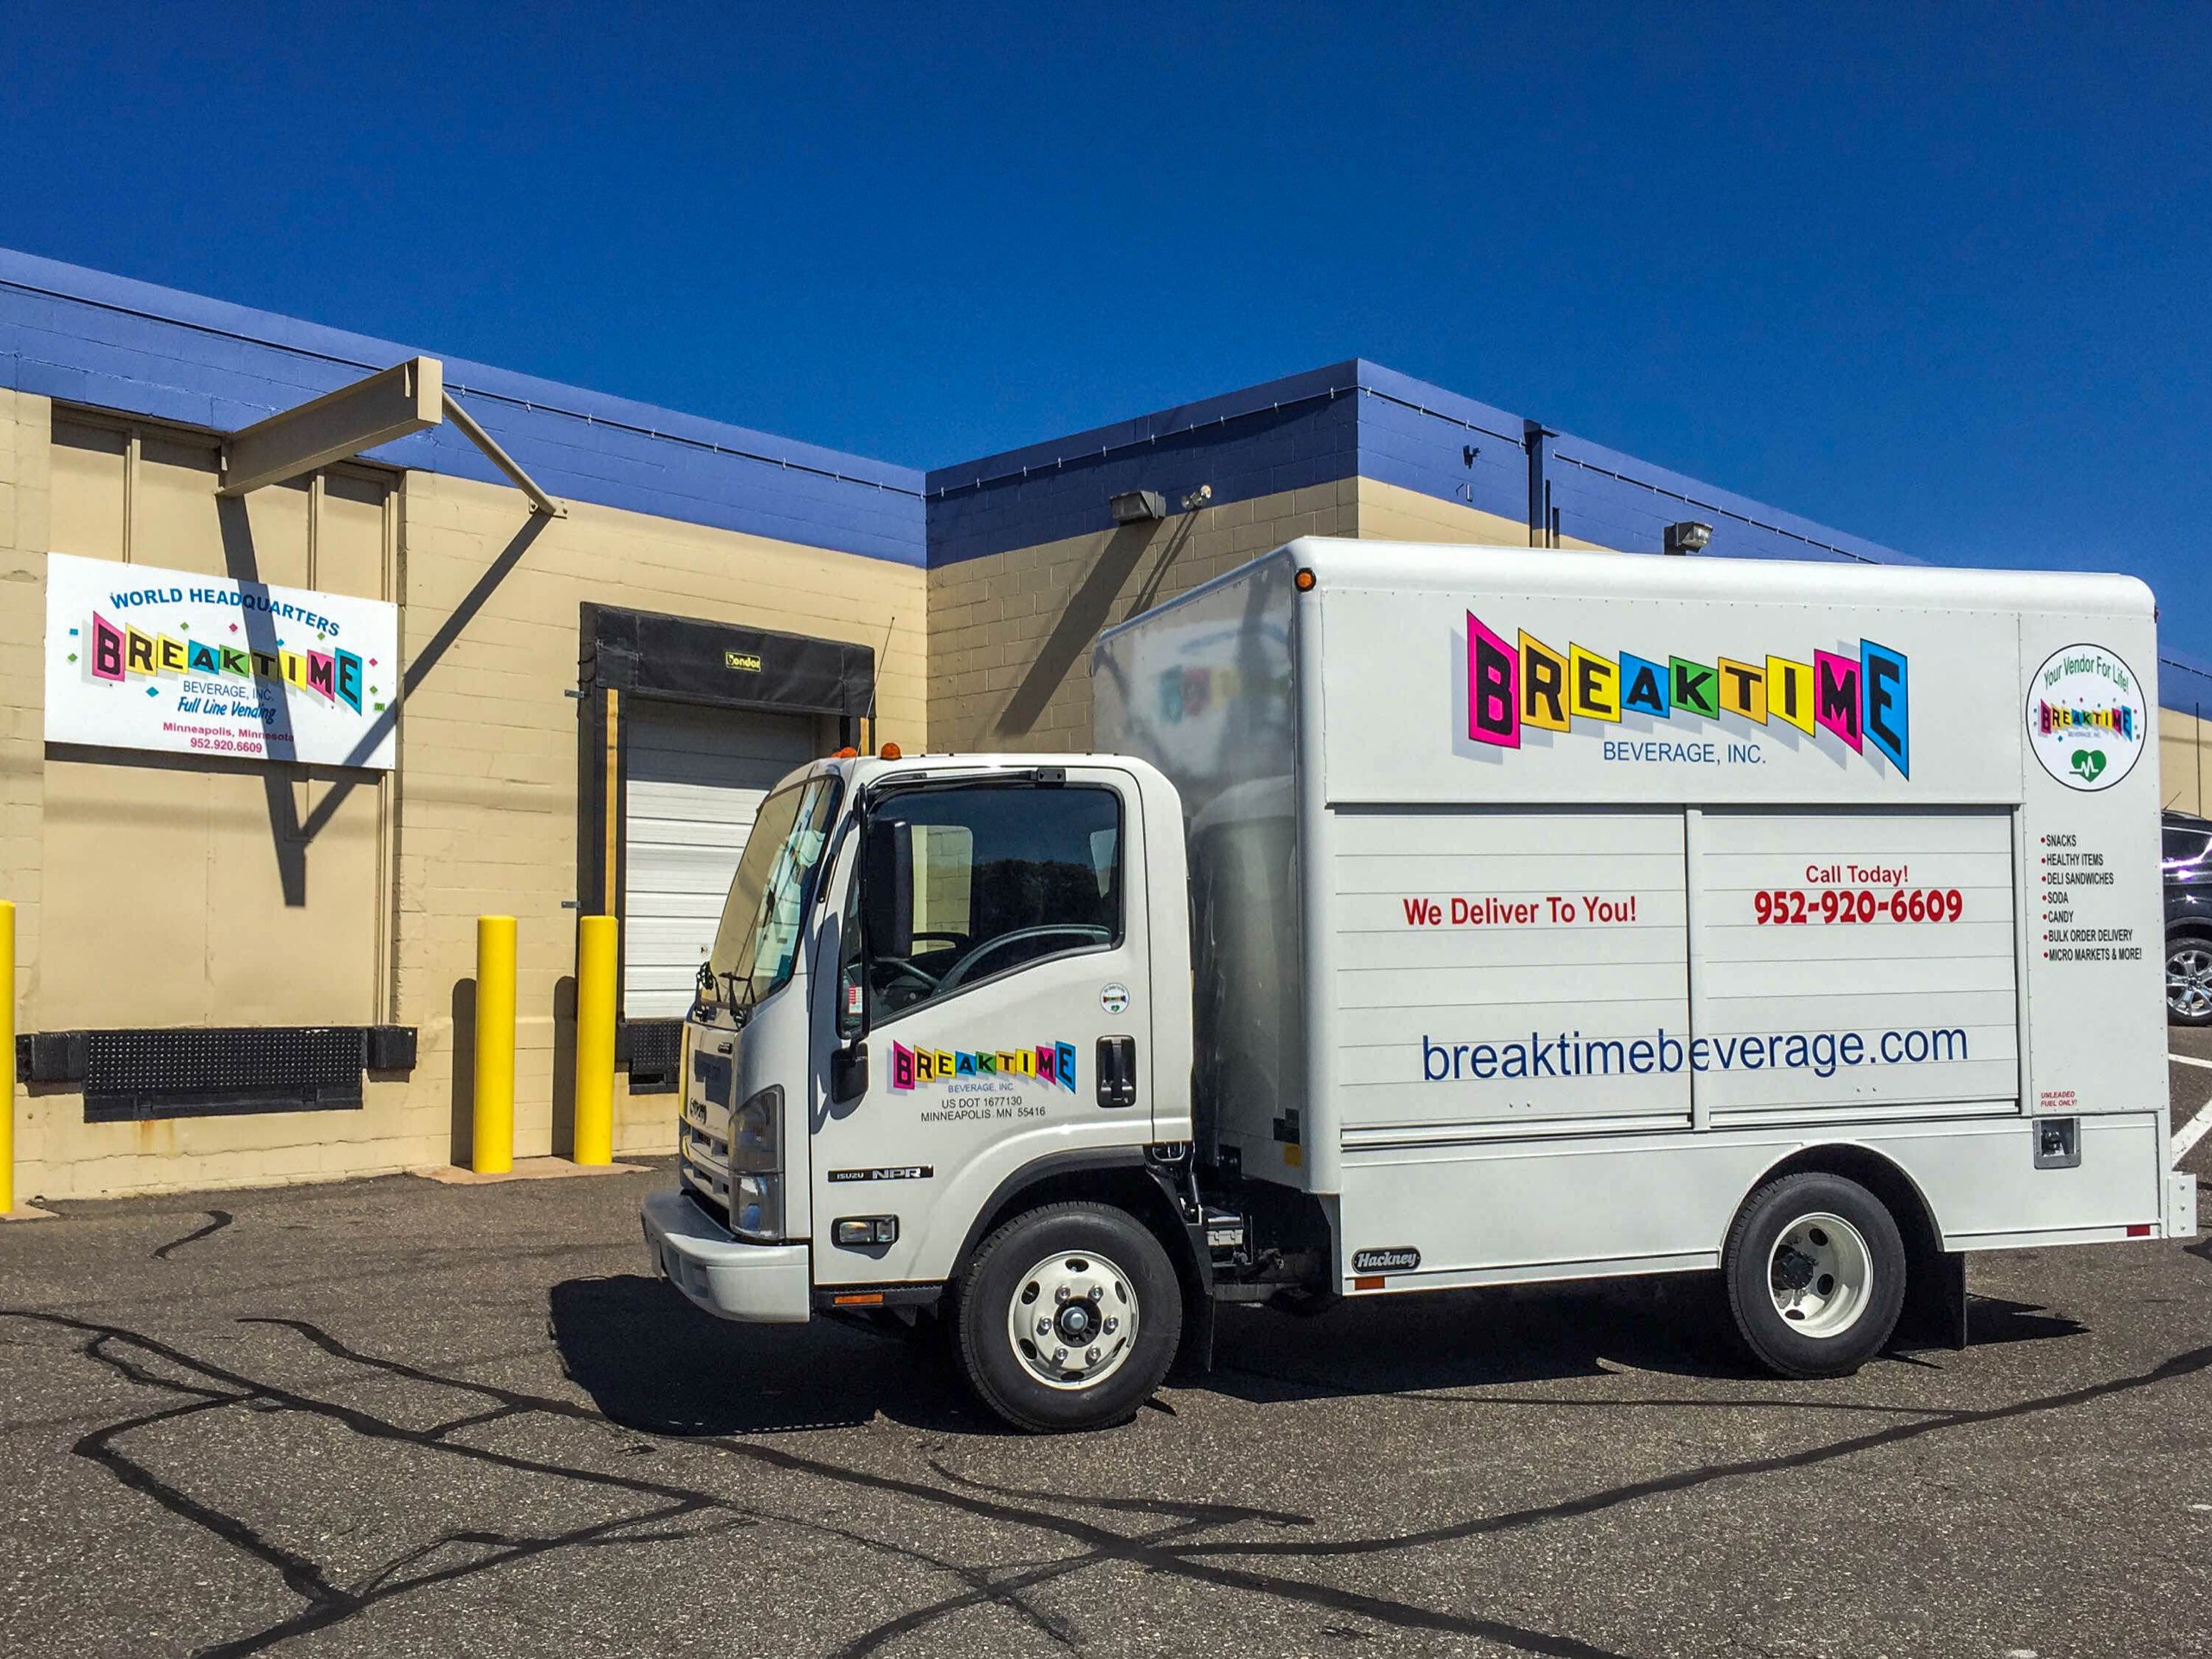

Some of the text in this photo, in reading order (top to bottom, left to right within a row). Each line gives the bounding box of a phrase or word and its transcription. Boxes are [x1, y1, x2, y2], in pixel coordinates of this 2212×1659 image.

[110, 588, 340, 638] WORLD HEADQUARTERS
[94, 614, 360, 712] BREAKTIME
[2044, 664, 2063, 690] Your
[2063, 653, 2094, 676] Vendor
[2096, 656, 2111, 678] For
[183, 680, 275, 701] BEVERAGE, INC.
[1469, 618, 1906, 771] BREAKTIME
[177, 696, 276, 725] Full Line Vending
[2041, 702, 2132, 740] BREAKTIME
[162, 721, 294, 742] Minneapolis, Minnesota
[190, 737, 263, 753] 952.920.6609
[1604, 741, 1766, 766] BEVERAGE, INC.
[2046, 835, 2076, 847] SNACKS
[2046, 854, 2104, 866] HEALTHY ITEMS
[1806, 865, 1908, 885] Call Today!
[2047, 873, 2114, 885] DELI SANDWICHES
[1754, 888, 1962, 925] 952-920-6609
[2047, 892, 2069, 904] SODA
[1403, 895, 1637, 925] We Deliver To You!
[2048, 911, 2074, 923] CANDY
[2049, 929, 2133, 942] BULK ORDER DELIVERY
[2049, 948, 2142, 961] MICRO MARKETS & MORE!
[1422, 1029, 1968, 1080] breaktimebeverage.com
[894, 1042, 1074, 1090] BREAKTIME
[942, 1096, 1022, 1109] US DOT 1677130
[996, 1109, 1012, 1117] MN
[1018, 1107, 1046, 1117] 55416
[872, 1167, 921, 1179] NPR
[1357, 1252, 1416, 1268] Hackney
